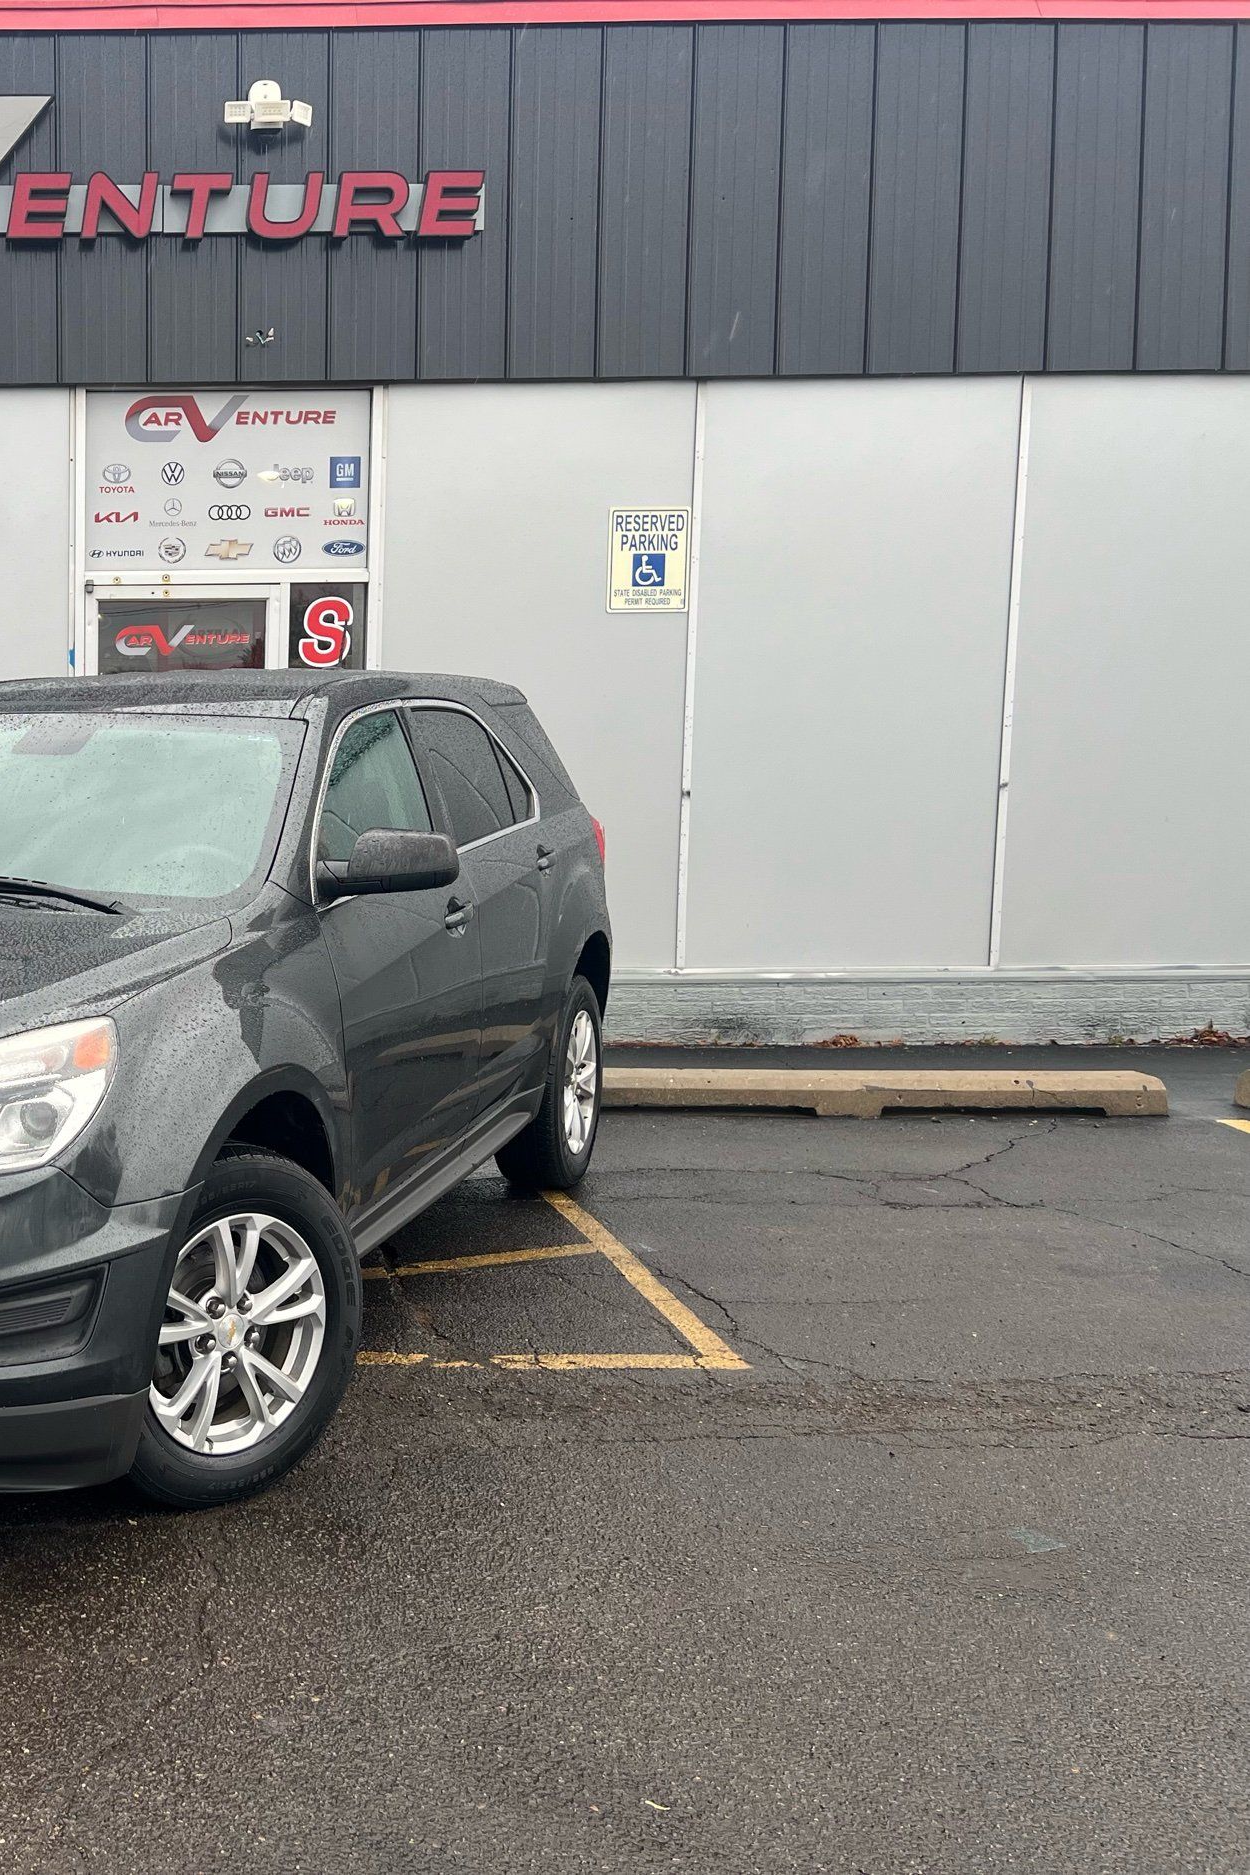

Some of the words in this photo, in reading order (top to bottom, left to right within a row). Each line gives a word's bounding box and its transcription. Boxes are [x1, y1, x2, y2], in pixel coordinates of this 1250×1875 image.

[215, 470, 244, 478] NISSAN
[336, 463, 354, 481] GM
[99, 486, 135, 494] TOYOTA
[94, 511, 138, 523] KIA
[264, 507, 310, 518] GMC
[615, 514, 684, 532] RESERVED
[620, 534, 678, 551] PARKING
[106, 549, 144, 557] HYUNDAI
[330, 543, 356, 554] Ford
[614, 589, 630, 597] STATE
[632, 589, 657, 597] DISABLED
[299, 596, 354, 667] S
